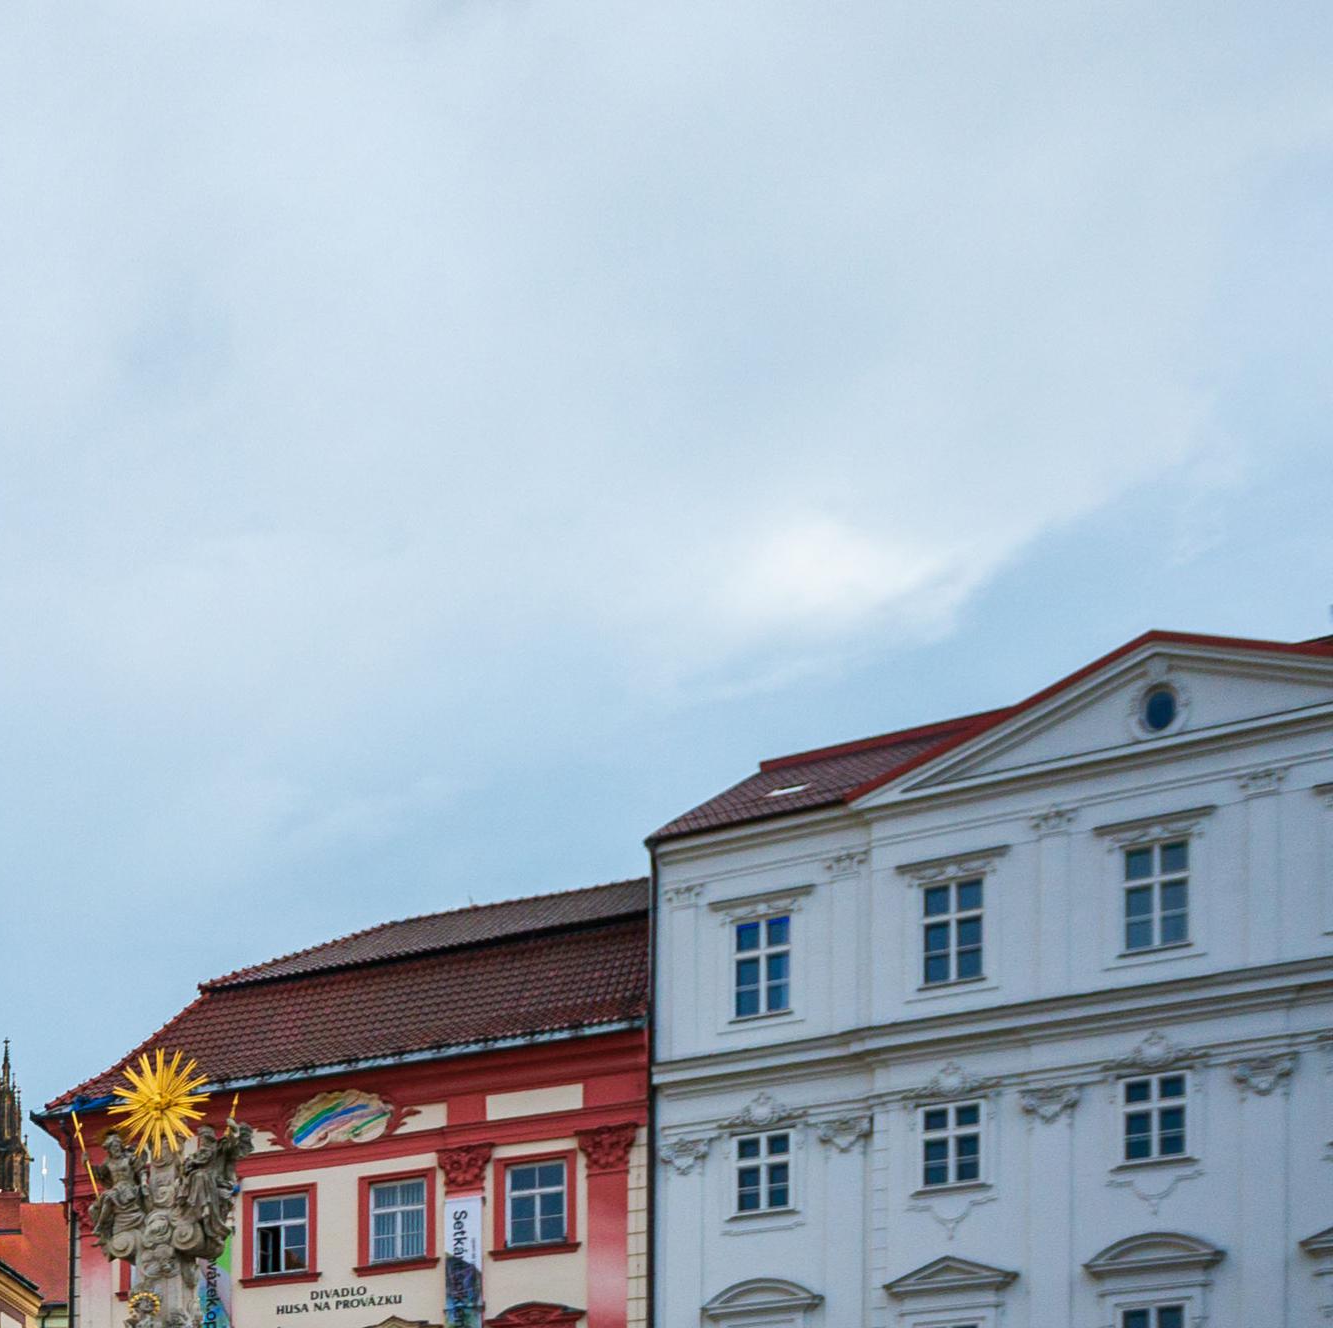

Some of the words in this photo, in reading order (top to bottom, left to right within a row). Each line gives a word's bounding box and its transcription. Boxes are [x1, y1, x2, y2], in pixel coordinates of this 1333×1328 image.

[309, 1285, 367, 1301] DIVADLO
[276, 1303, 309, 1315] HUSA
[313, 1302, 331, 1312] NA
[335, 1294, 403, 1310] PROVÁZKU
